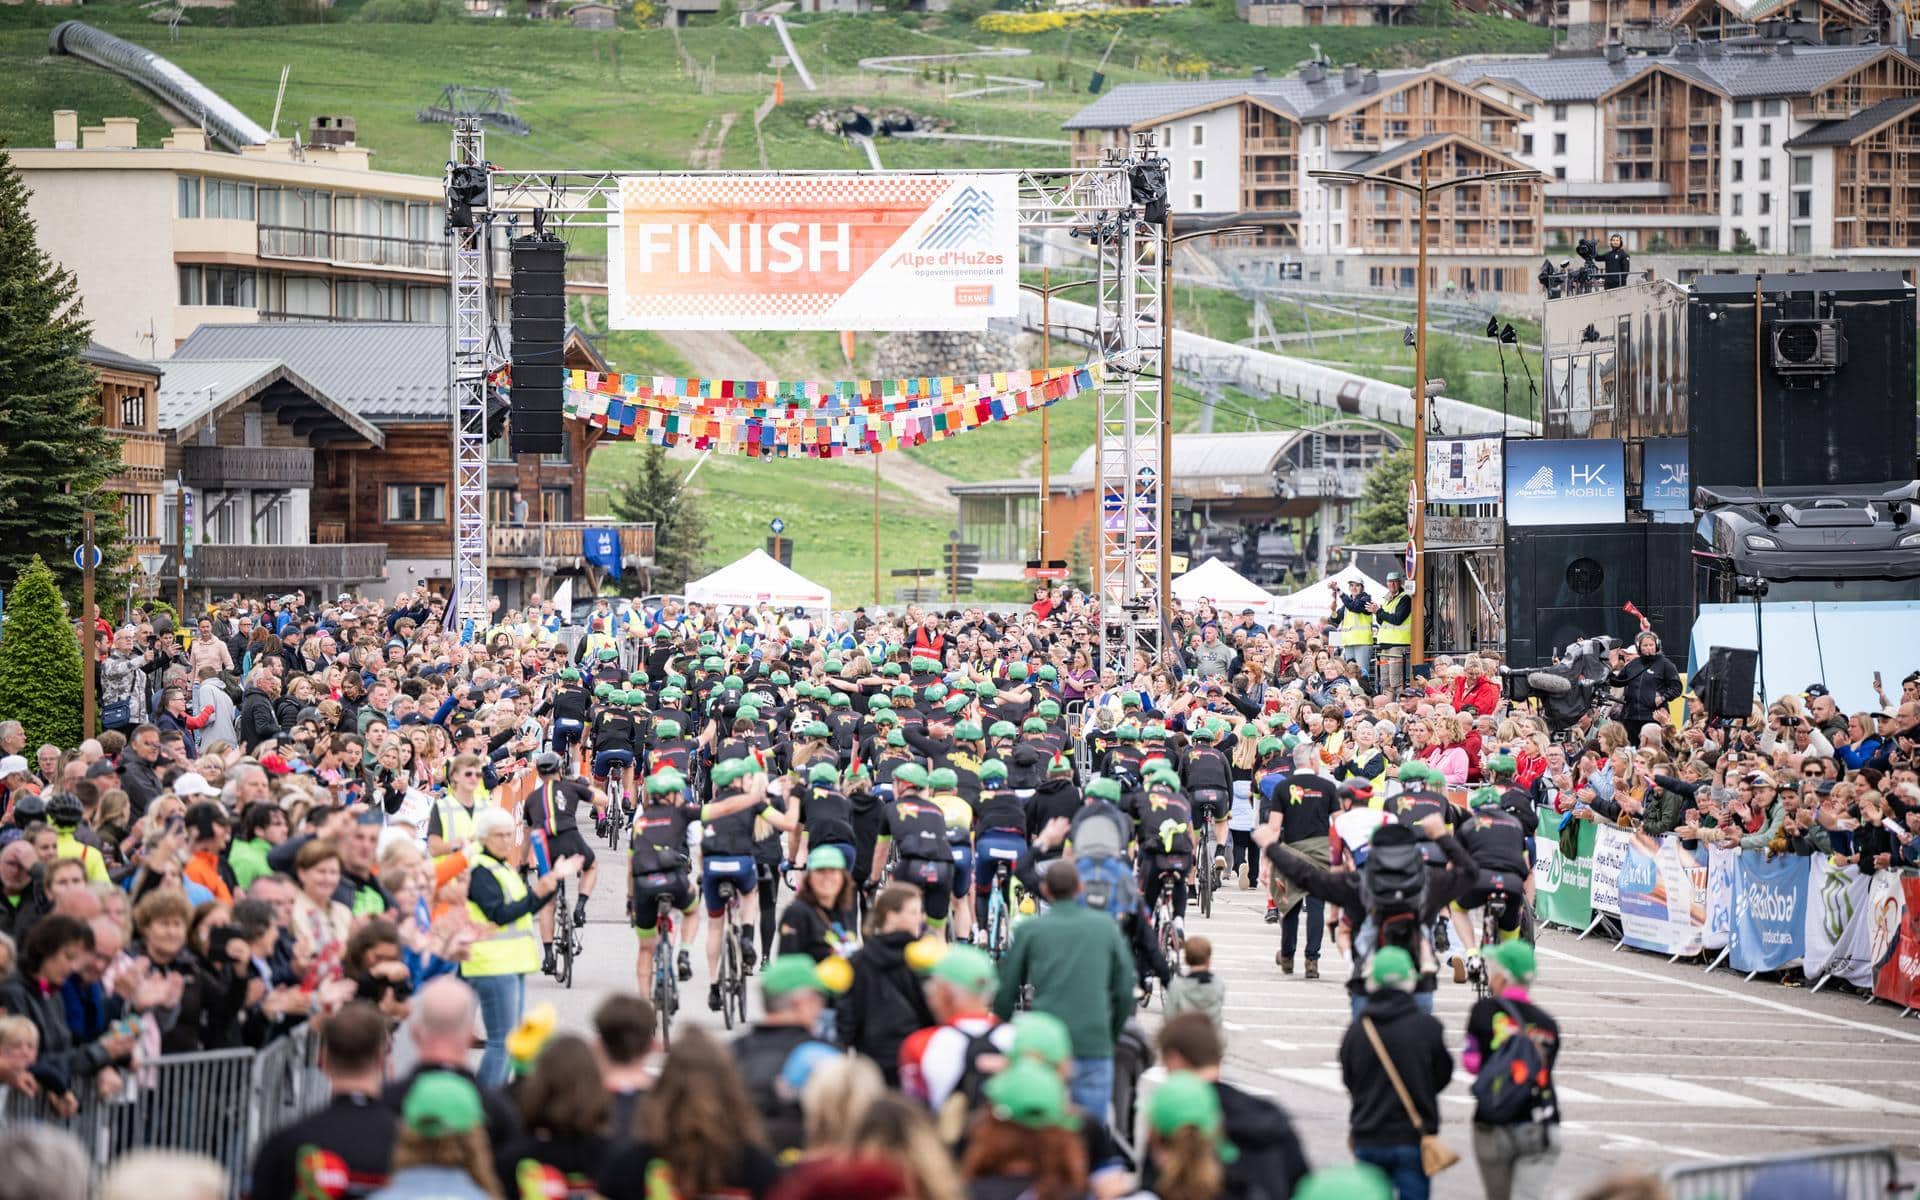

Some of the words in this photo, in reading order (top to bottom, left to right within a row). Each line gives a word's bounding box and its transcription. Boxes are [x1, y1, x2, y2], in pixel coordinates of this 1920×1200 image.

[639, 222, 850, 273] FINISH
[890, 252, 935, 269] Alpe
[939, 251, 1004, 265] d'HuZes
[914, 268, 1004, 277] opgevenisgeenoptie.nl
[1565, 488, 1615, 497] MOBILE
